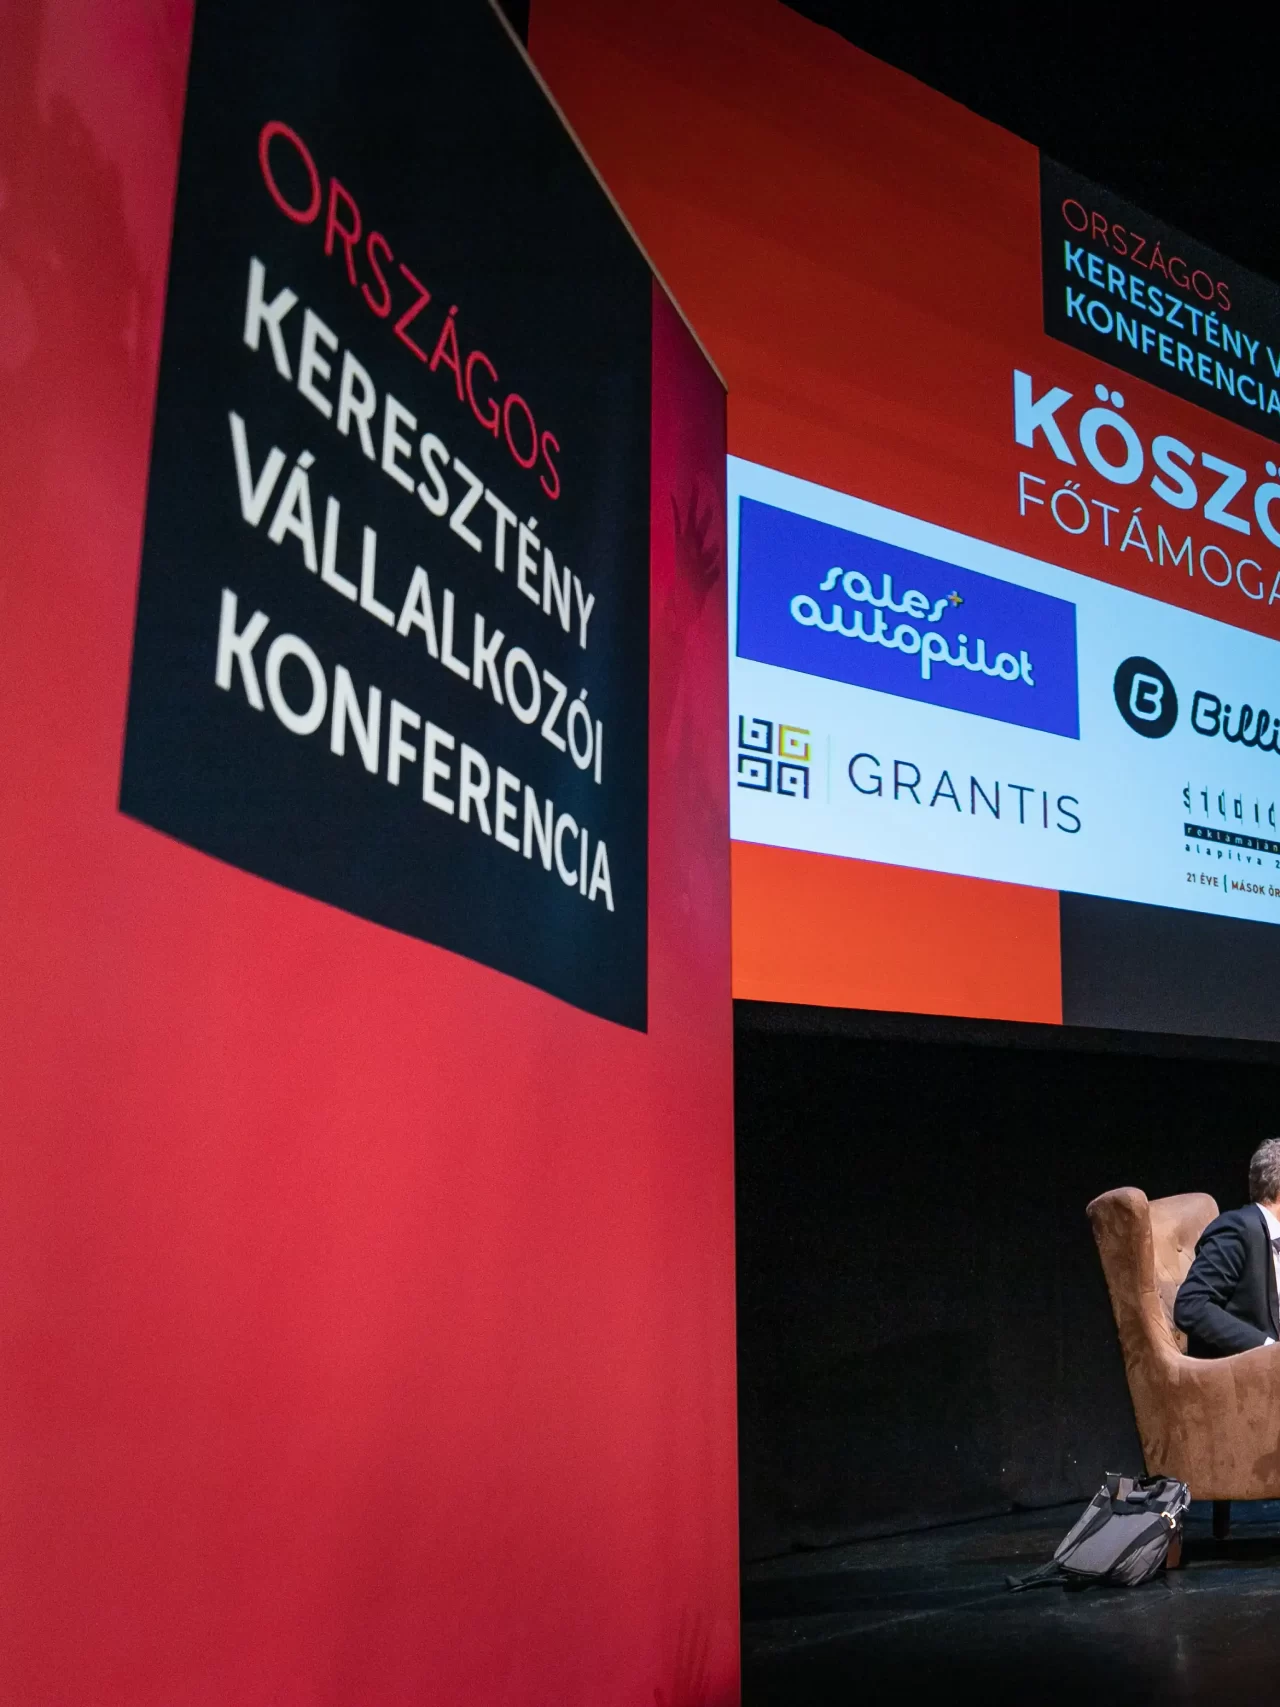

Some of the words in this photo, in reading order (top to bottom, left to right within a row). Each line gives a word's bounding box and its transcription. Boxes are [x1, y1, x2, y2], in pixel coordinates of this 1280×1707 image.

[259, 121, 561, 500] ORSZÁGOS
[1062, 198, 1231, 311] ORSZÁGOS
[1064, 240, 1260, 366] KERESZTÉNY
[243, 256, 594, 649] KERESZTÉNY
[229, 410, 603, 785] VÁLLALKOZÓI
[790, 594, 1036, 686] autopilot
[819, 566, 949, 622] sales
[214, 586, 614, 912] KONFERENCIA
[848, 752, 1082, 834] GRANTIS
[1187, 872, 1196, 883] 21
[1232, 879, 1265, 895] MÁSOK
